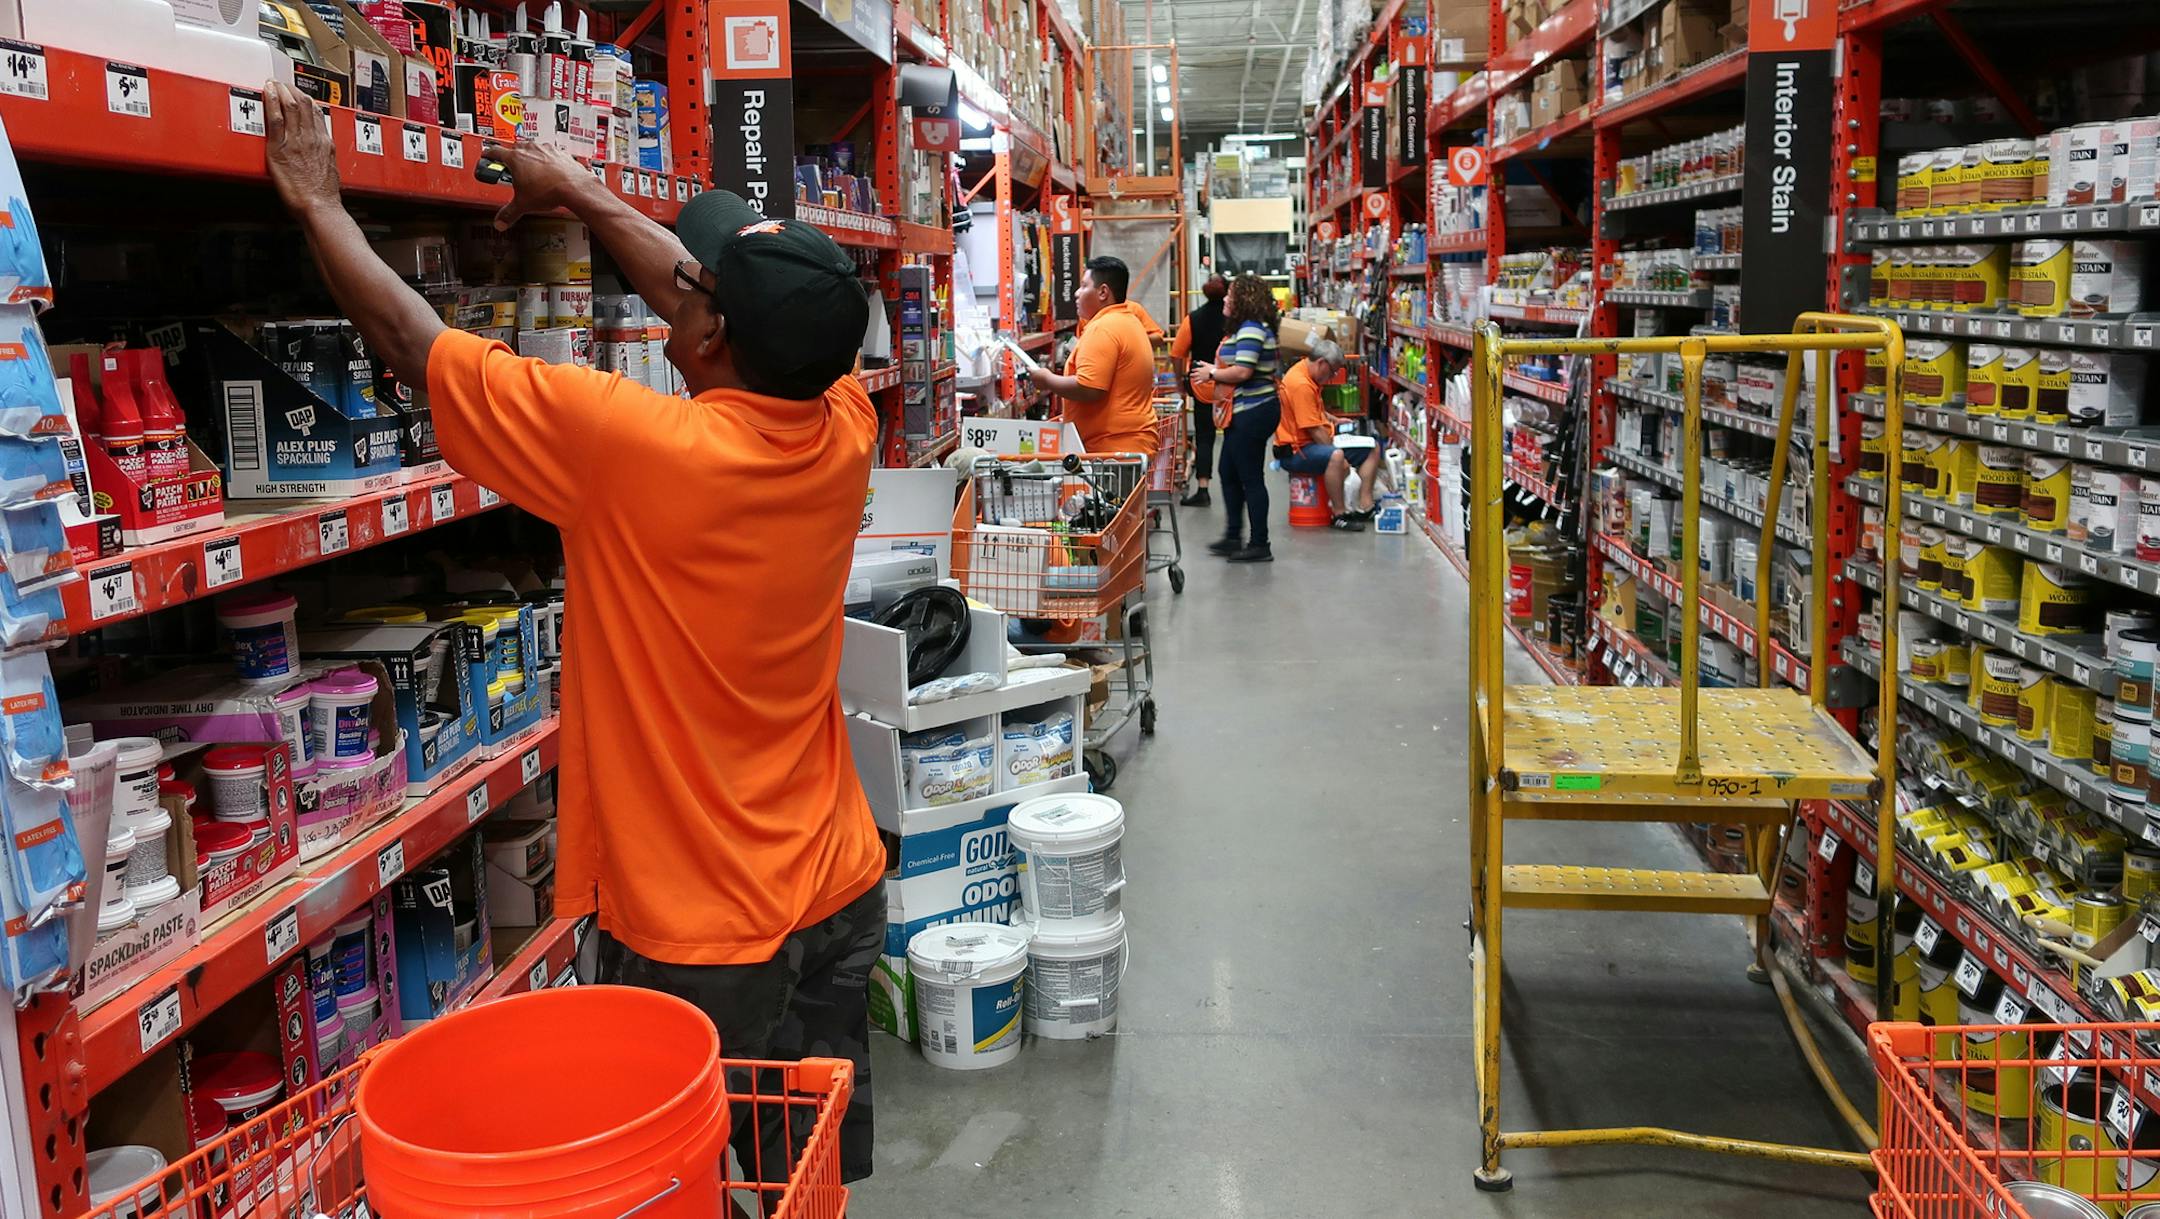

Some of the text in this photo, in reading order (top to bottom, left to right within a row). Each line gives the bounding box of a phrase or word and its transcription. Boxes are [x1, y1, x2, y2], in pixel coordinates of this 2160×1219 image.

[421, 45, 454, 67] ADY
[553, 57, 565, 89] Glazing
[575, 64, 589, 95] Glazing
[740, 90, 767, 174] Repair
[1407, 116, 1417, 159] Cleaners
[1771, 62, 1800, 233] Interior Stain
[1463, 157, 1473, 170] 5
[1984, 167, 2033, 179] WOOD STAIN
[1062, 237, 1072, 272] Buckets
[2079, 263, 2106, 273] STAIN
[560, 290, 592, 303] DURHAM
[904, 291, 920, 301] 3M
[1062, 280, 1072, 302] Rags
[152, 329, 182, 347] DAP
[2078, 373, 2103, 384] STAIN
[40, 418, 55, 429] 10
[290, 407, 313, 426] DAP
[384, 429, 398, 442] PLUS
[967, 427, 998, 449] $897
[276, 440, 336, 453] ALEX PLUS
[370, 443, 396, 460] SPACKLING
[276, 452, 331, 465] SPACKLING
[155, 483, 183, 498] PATCH
[255, 482, 326, 494] HIGH STRENGTH
[156, 498, 183, 509] PAINT
[214, 549, 232, 570] $497
[102, 576, 122, 600] $697
[120, 702, 214, 716] DRY TIME INDICATOR
[1011, 756, 1040, 776] ODOR
[923, 780, 953, 799] ODOR
[1707, 778, 1762, 796] 950-1
[22, 832, 41, 843] LATEX
[208, 859, 238, 882] PATCH
[967, 863, 989, 875] natural
[209, 870, 236, 893] PAINT
[228, 881, 264, 909] LIGHTWEIGHT
[429, 881, 451, 904] DA
[964, 876, 1020, 907] ODO
[89, 932, 150, 980] SPACKLING
[152, 913, 184, 946] PASTE
